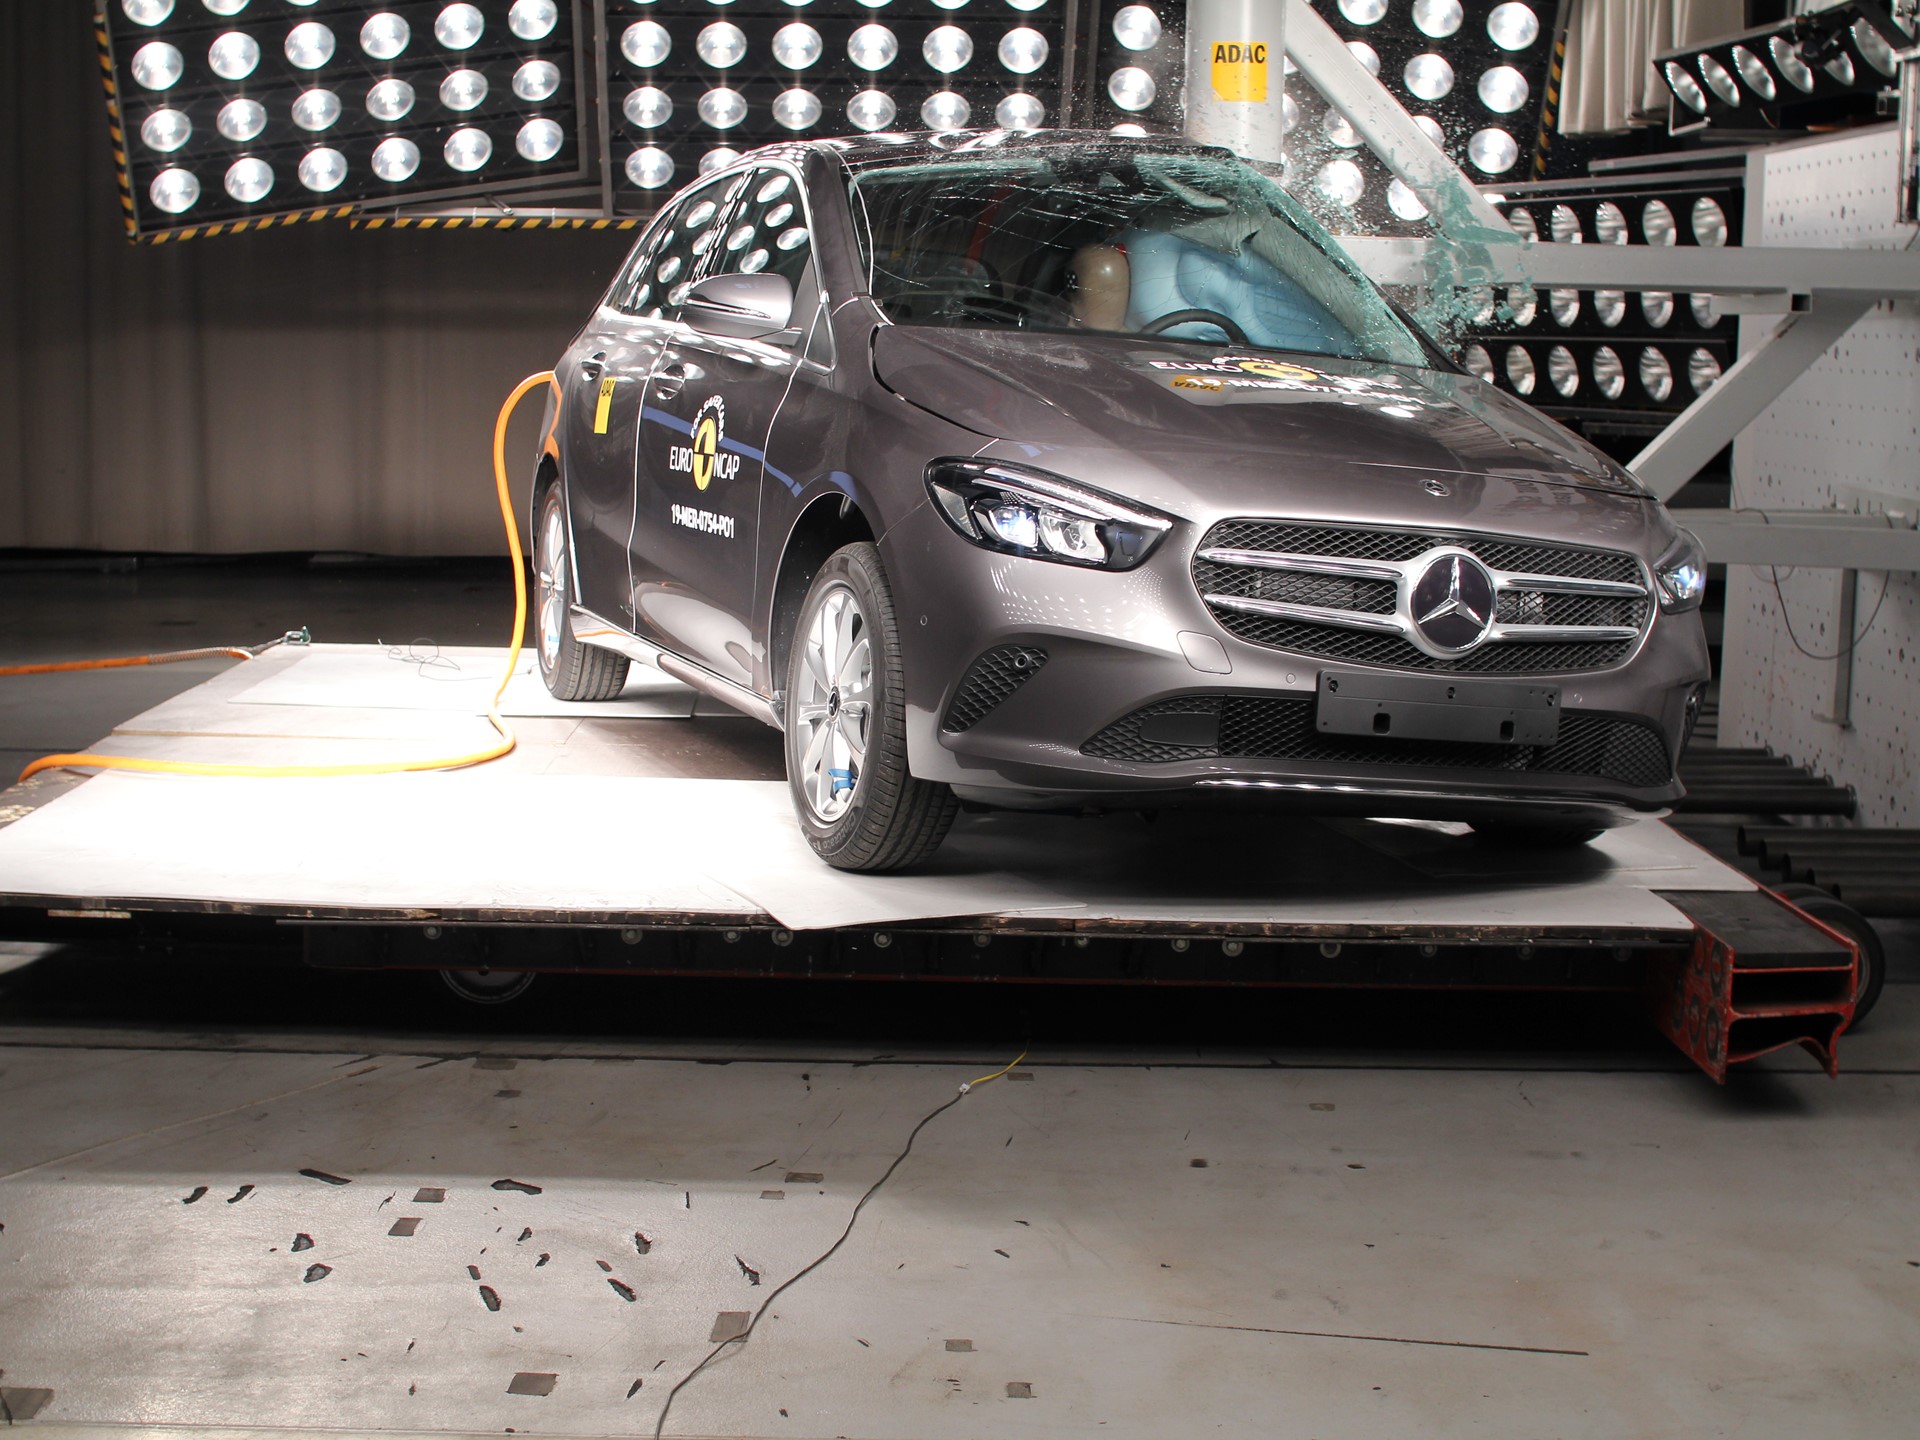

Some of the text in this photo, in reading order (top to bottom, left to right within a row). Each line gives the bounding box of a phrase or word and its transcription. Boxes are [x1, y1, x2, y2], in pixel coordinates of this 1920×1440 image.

[1214, 44, 1266, 64] ADAC
[1149, 361, 1243, 373] EURO
[690, 408, 703, 440] FOR
[669, 445, 740, 480] EURO NCAP
